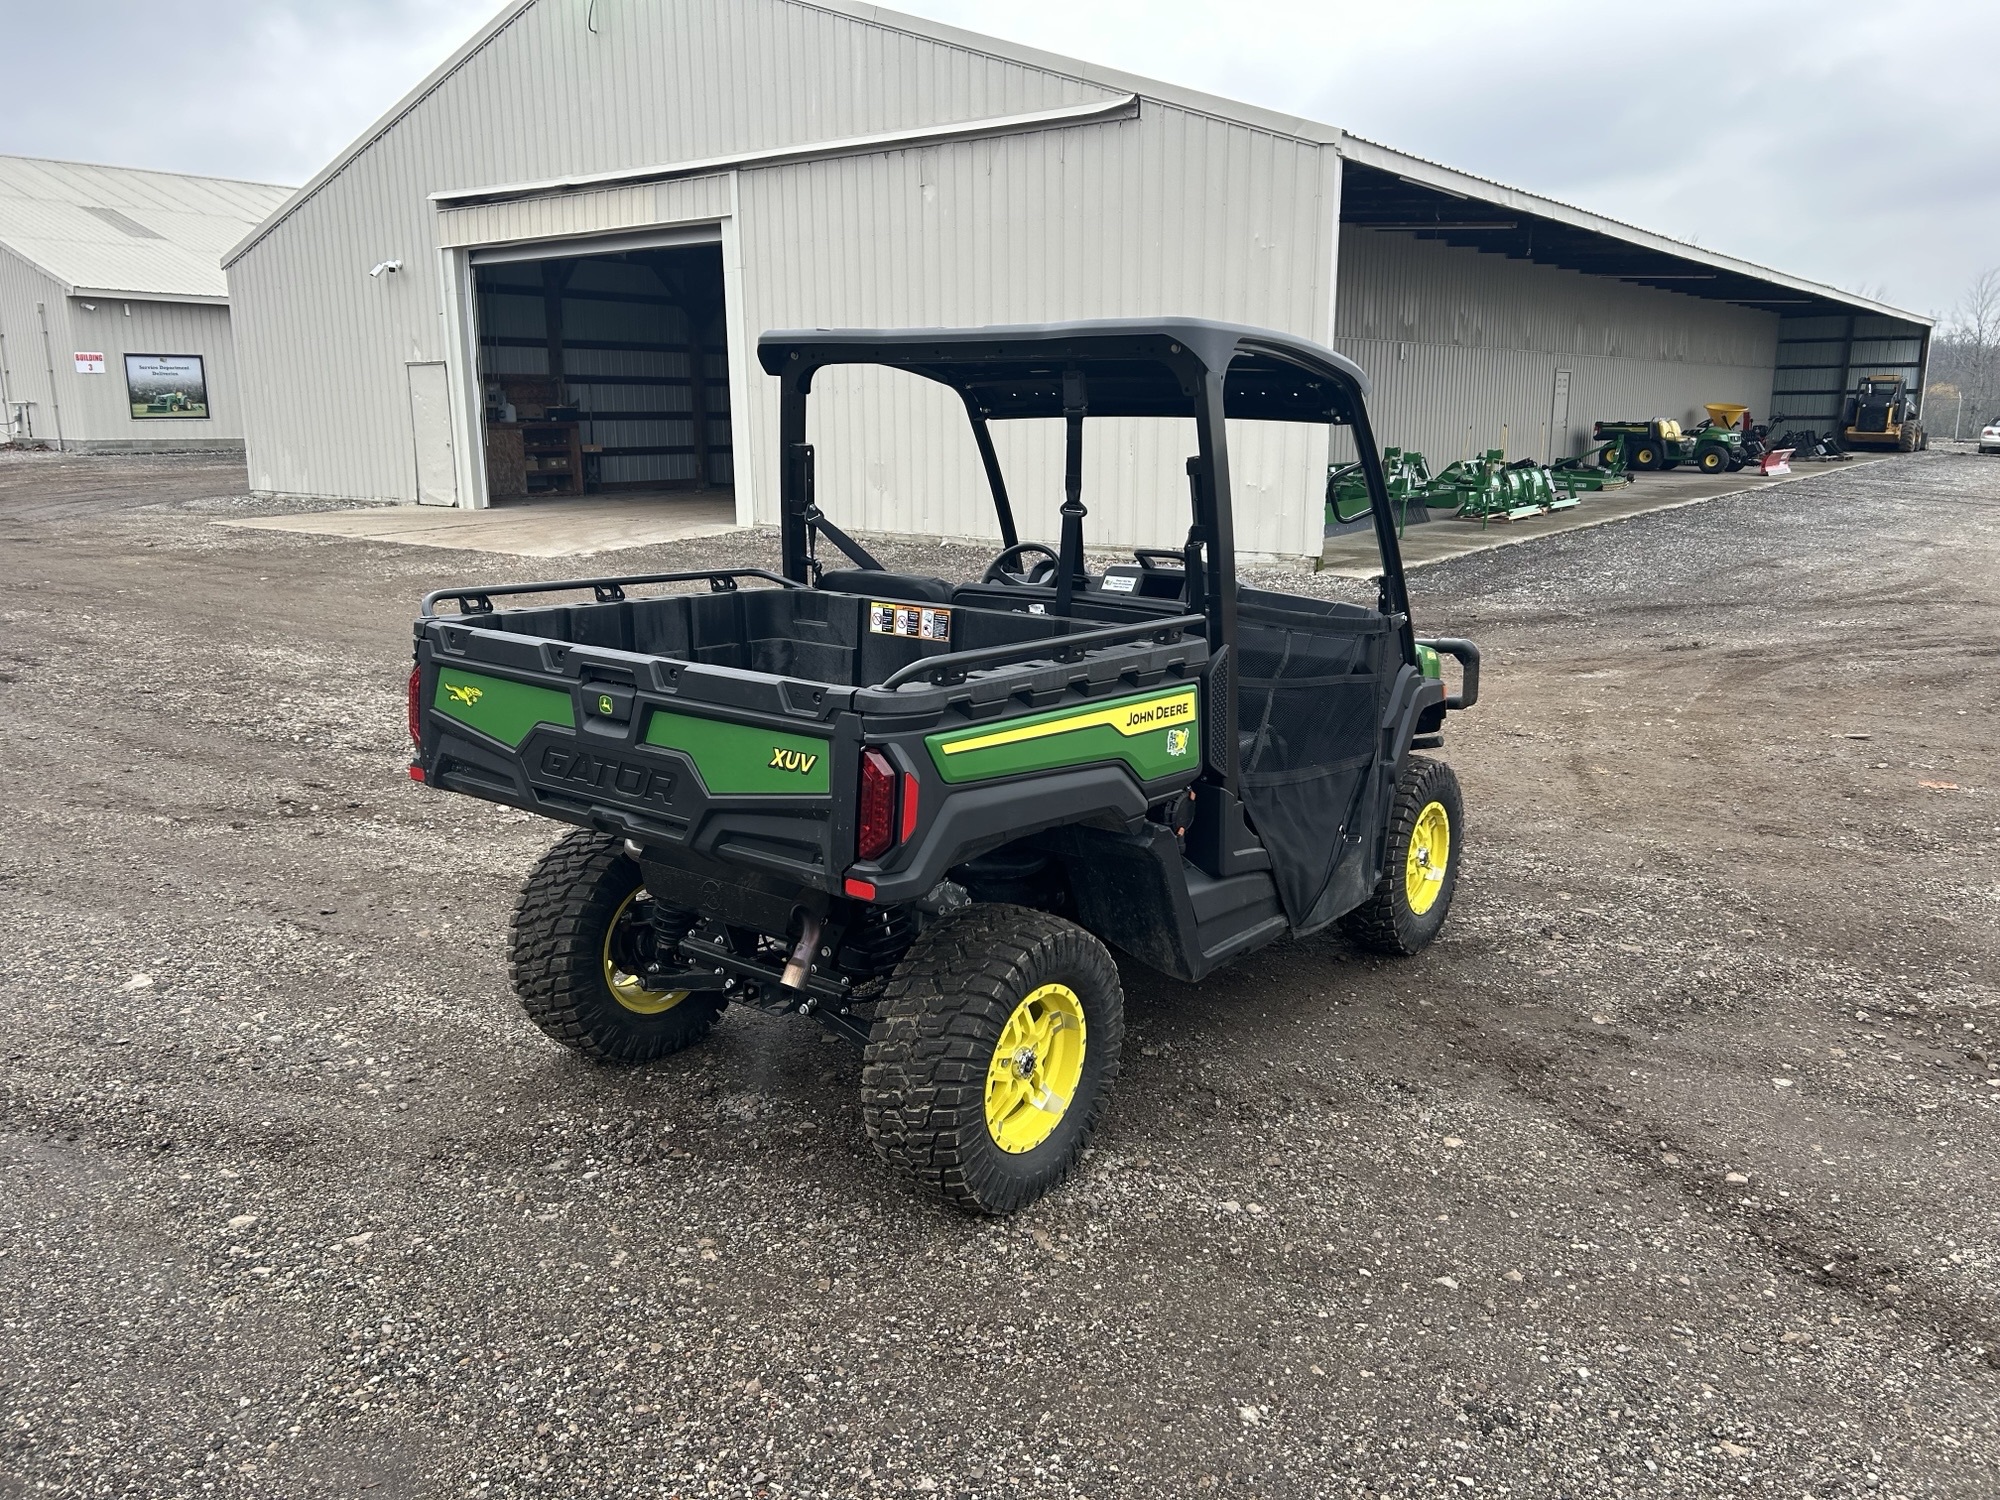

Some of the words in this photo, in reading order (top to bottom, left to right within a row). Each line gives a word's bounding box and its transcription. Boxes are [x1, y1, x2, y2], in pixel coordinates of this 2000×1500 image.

[75, 354, 103, 362] BUILDING
[88, 363, 93, 371] 3
[1126, 710, 1154, 727] JOHN
[1156, 703, 1188, 720] DEERE
[768, 747, 819, 775] XUV
[540, 746, 678, 806] GATOR
